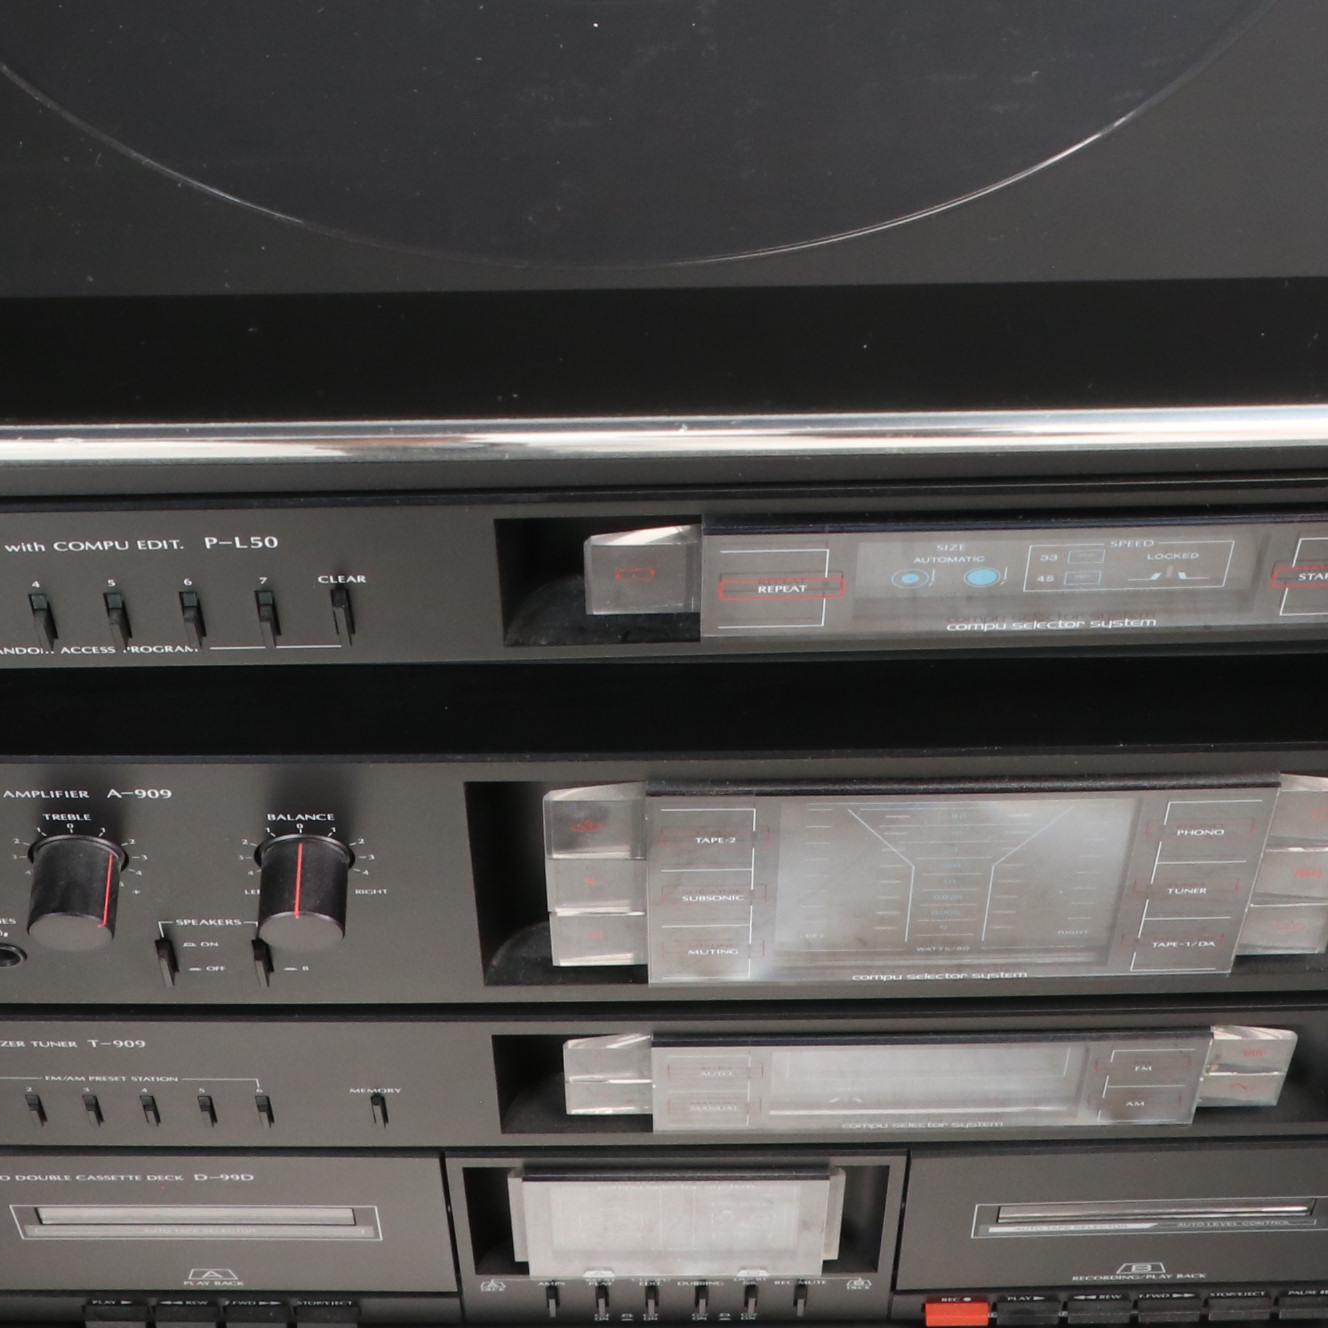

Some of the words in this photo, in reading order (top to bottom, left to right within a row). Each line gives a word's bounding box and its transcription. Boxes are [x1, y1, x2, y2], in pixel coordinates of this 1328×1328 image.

[4, 542, 46, 553] with
[54, 540, 129, 552] COMPU
[137, 540, 184, 550] EDIT.
[204, 536, 279, 550] P-L50
[937, 544, 966, 552] SIZE
[1110, 539, 1155, 548] SPEED
[914, 555, 985, 564] AUTOMATIC
[1147, 552, 1199, 561] LOCKED
[108, 579, 115, 587] 5
[183, 578, 192, 586] 6
[259, 577, 267, 585] 7
[318, 575, 366, 584] CLEAR
[758, 585, 807, 593] REPEAT
[946, 622, 1007, 633] compu
[1012, 619, 1085, 630] selector
[1089, 618, 1156, 630] system
[3, 790, 89, 799] AMPLIFIER
[107, 789, 172, 799] A-909
[681, 894, 745, 902] SUBSONIC
[687, 948, 739, 956] MUTING
[852, 974, 902, 982] compu
[906, 972, 968, 981] selector
[972, 972, 1028, 980] system
[31, 1040, 77, 1048] TUNER
[87, 1039, 146, 1048] T-909
